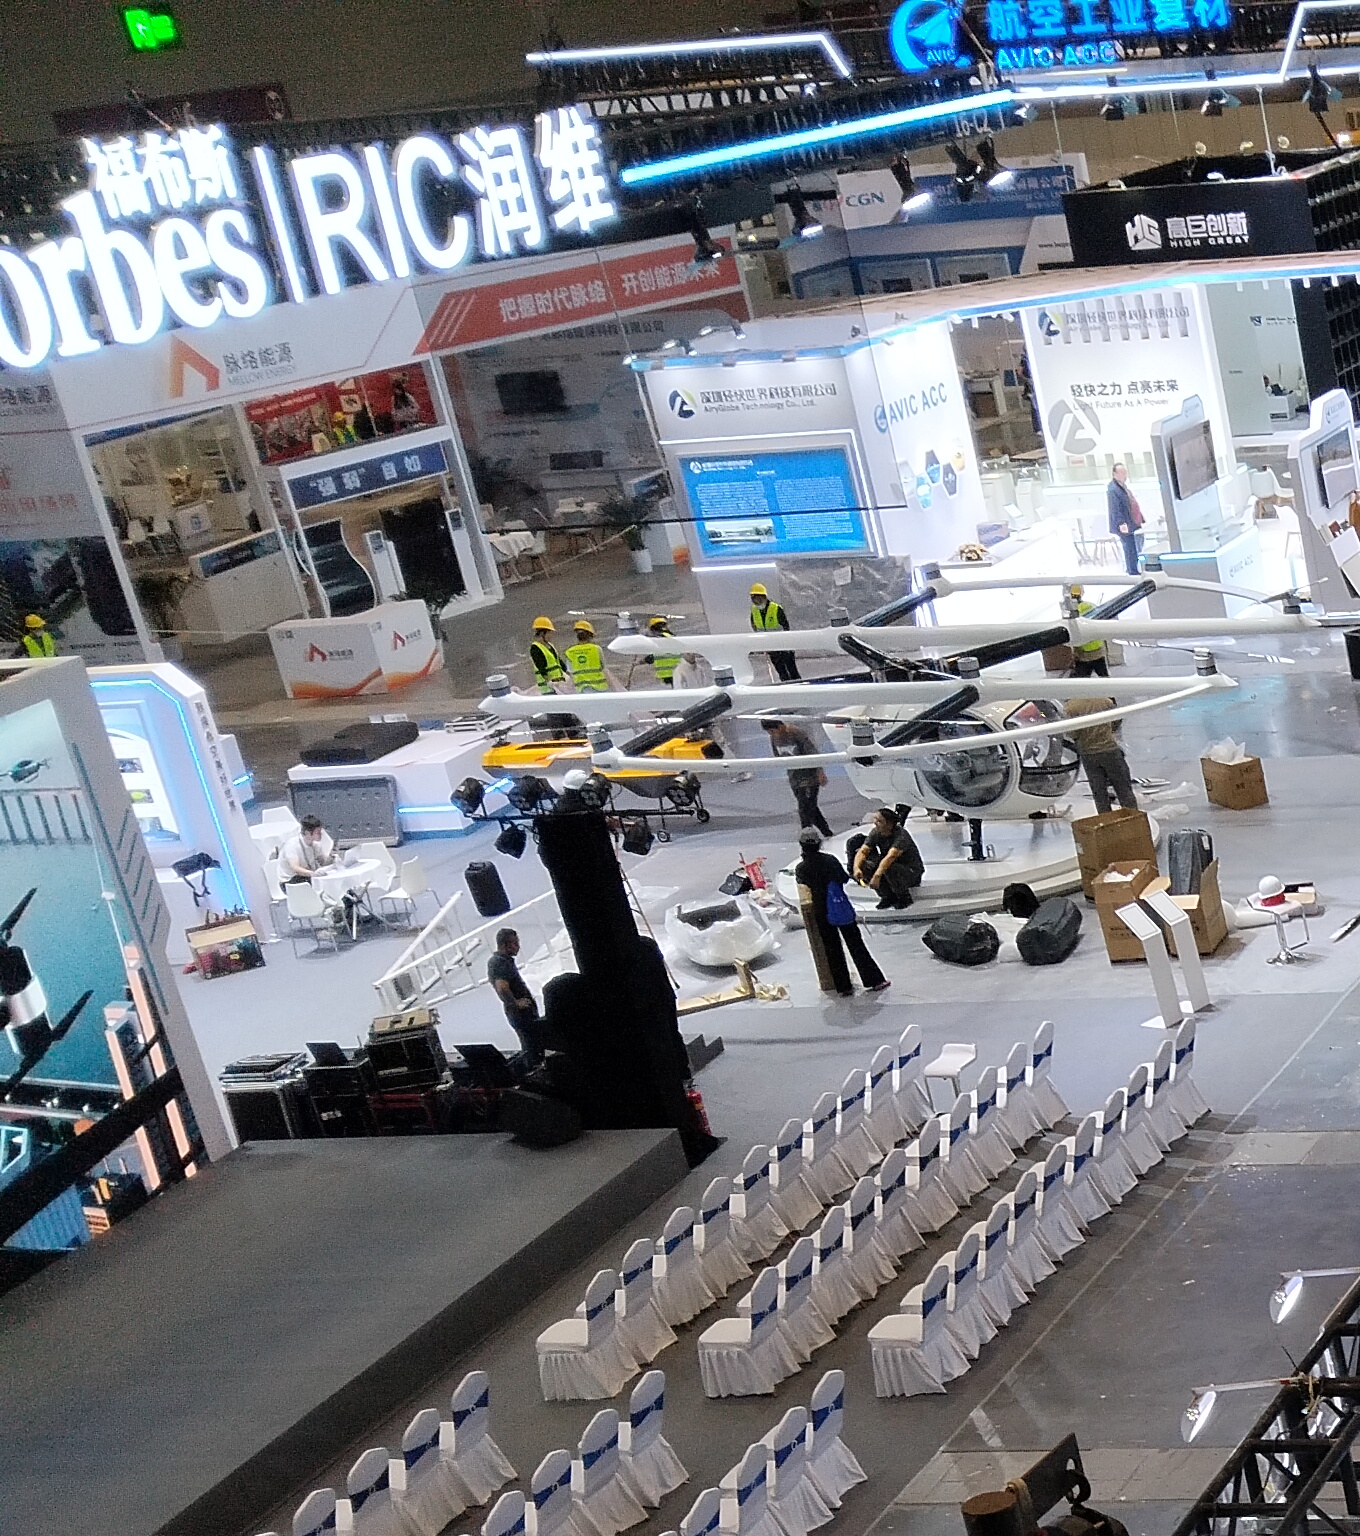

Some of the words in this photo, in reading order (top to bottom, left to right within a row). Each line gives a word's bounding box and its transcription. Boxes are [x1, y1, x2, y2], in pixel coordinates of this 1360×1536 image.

[997, 49, 1054, 70] AVIC
[82, 124, 238, 218] 福布斯
[1167, 212, 1248, 240] 高巨创新
[499, 279, 607, 324] 把握时代脉络
[1069, 381, 1123, 399] 轻快之力
[1127, 378, 1180, 395] 点亮未来
